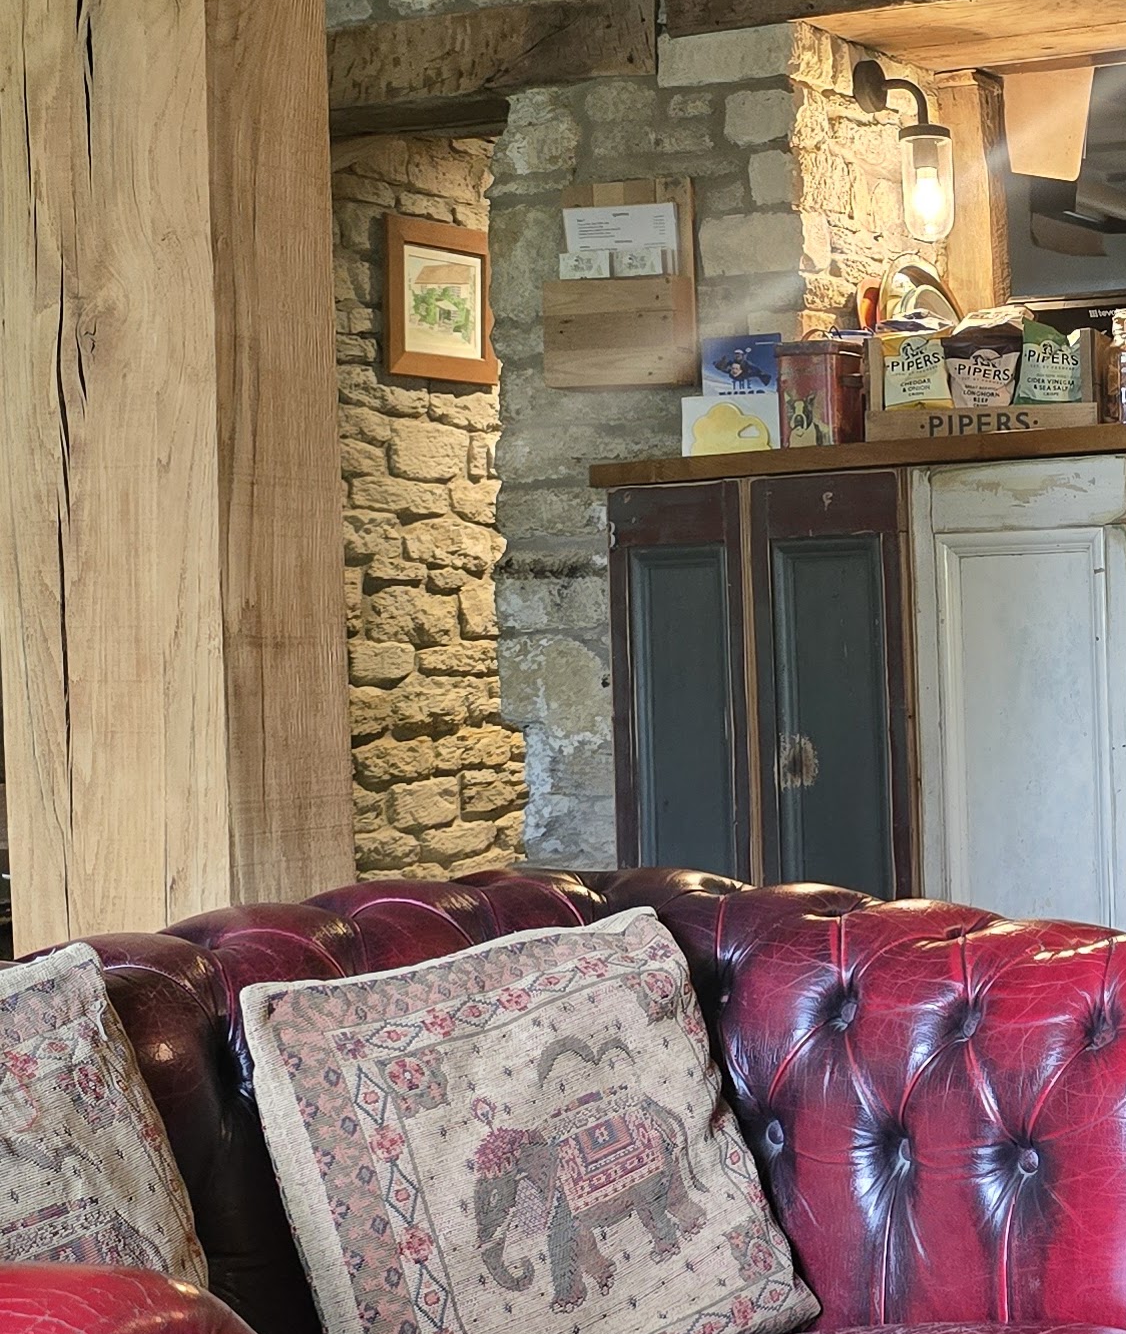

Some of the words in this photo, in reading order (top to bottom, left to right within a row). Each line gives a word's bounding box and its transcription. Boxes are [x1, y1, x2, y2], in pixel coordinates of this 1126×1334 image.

[891, 352, 941, 372] PIPERS
[1027, 349, 1079, 366] PIPERS
[957, 363, 1010, 381] PIPERS
[732, 379, 752, 391] THE
[900, 378, 931, 387] CHEDDAR
[963, 389, 1000, 398] LONGHORN
[929, 411, 1030, 436] PIPERS
